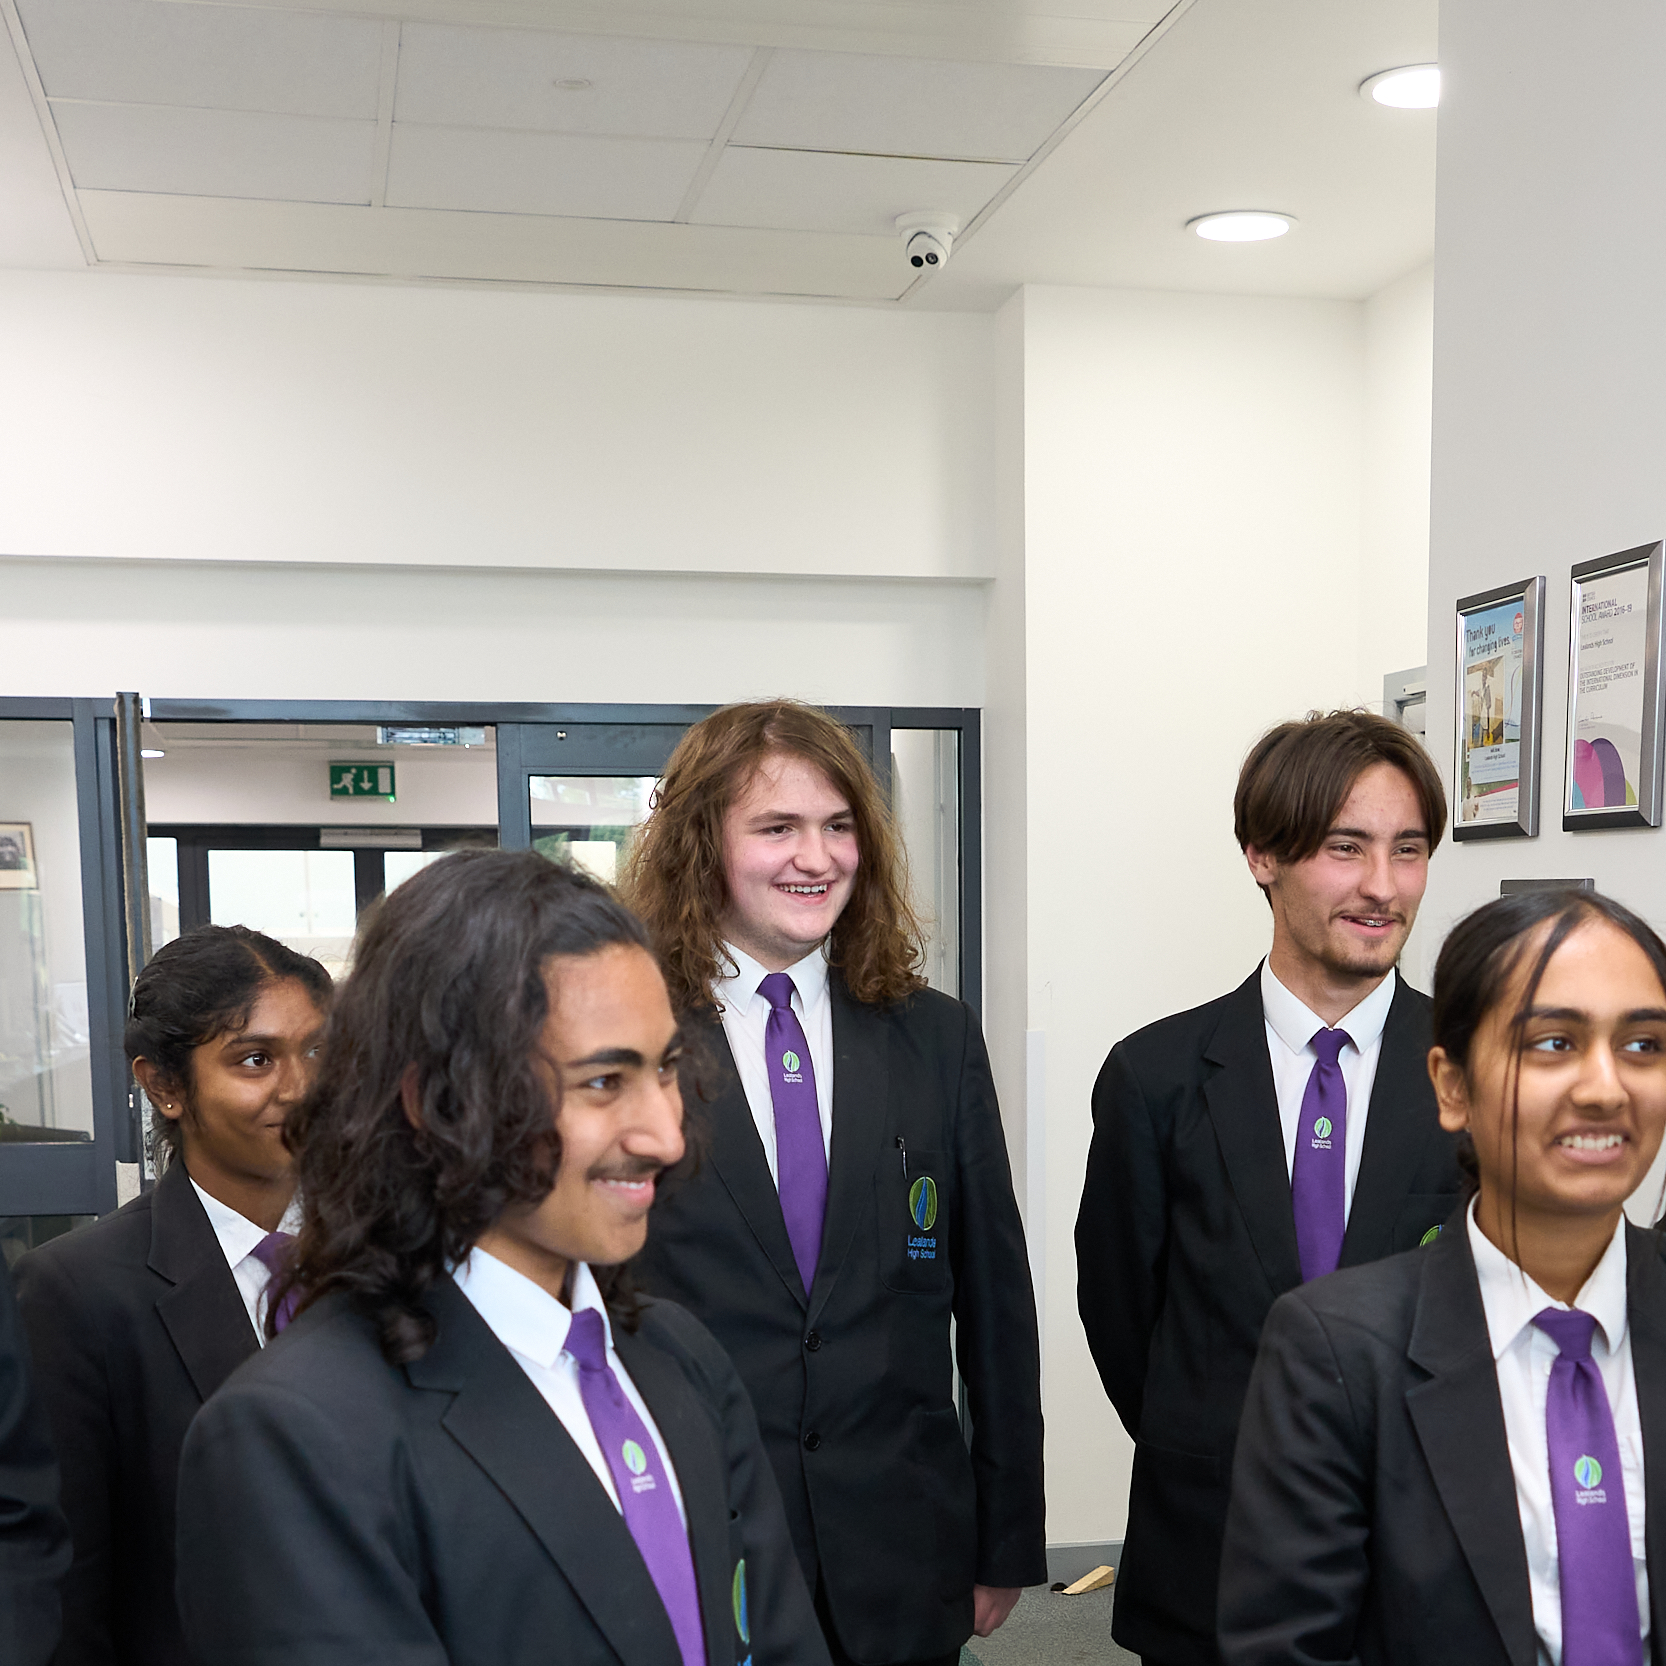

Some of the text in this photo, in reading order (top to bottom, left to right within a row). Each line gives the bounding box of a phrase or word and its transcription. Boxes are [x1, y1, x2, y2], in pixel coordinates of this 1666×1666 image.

[1581, 598, 1618, 615] INTERNATIONAL
[1581, 613, 1597, 624] SCHOOL
[1598, 608, 1613, 619] AWARD
[1466, 623, 1496, 643] Thank you
[1476, 640, 1498, 655] changing
[907, 1234, 936, 1248] Lealands
[907, 1248, 936, 1260] High School
